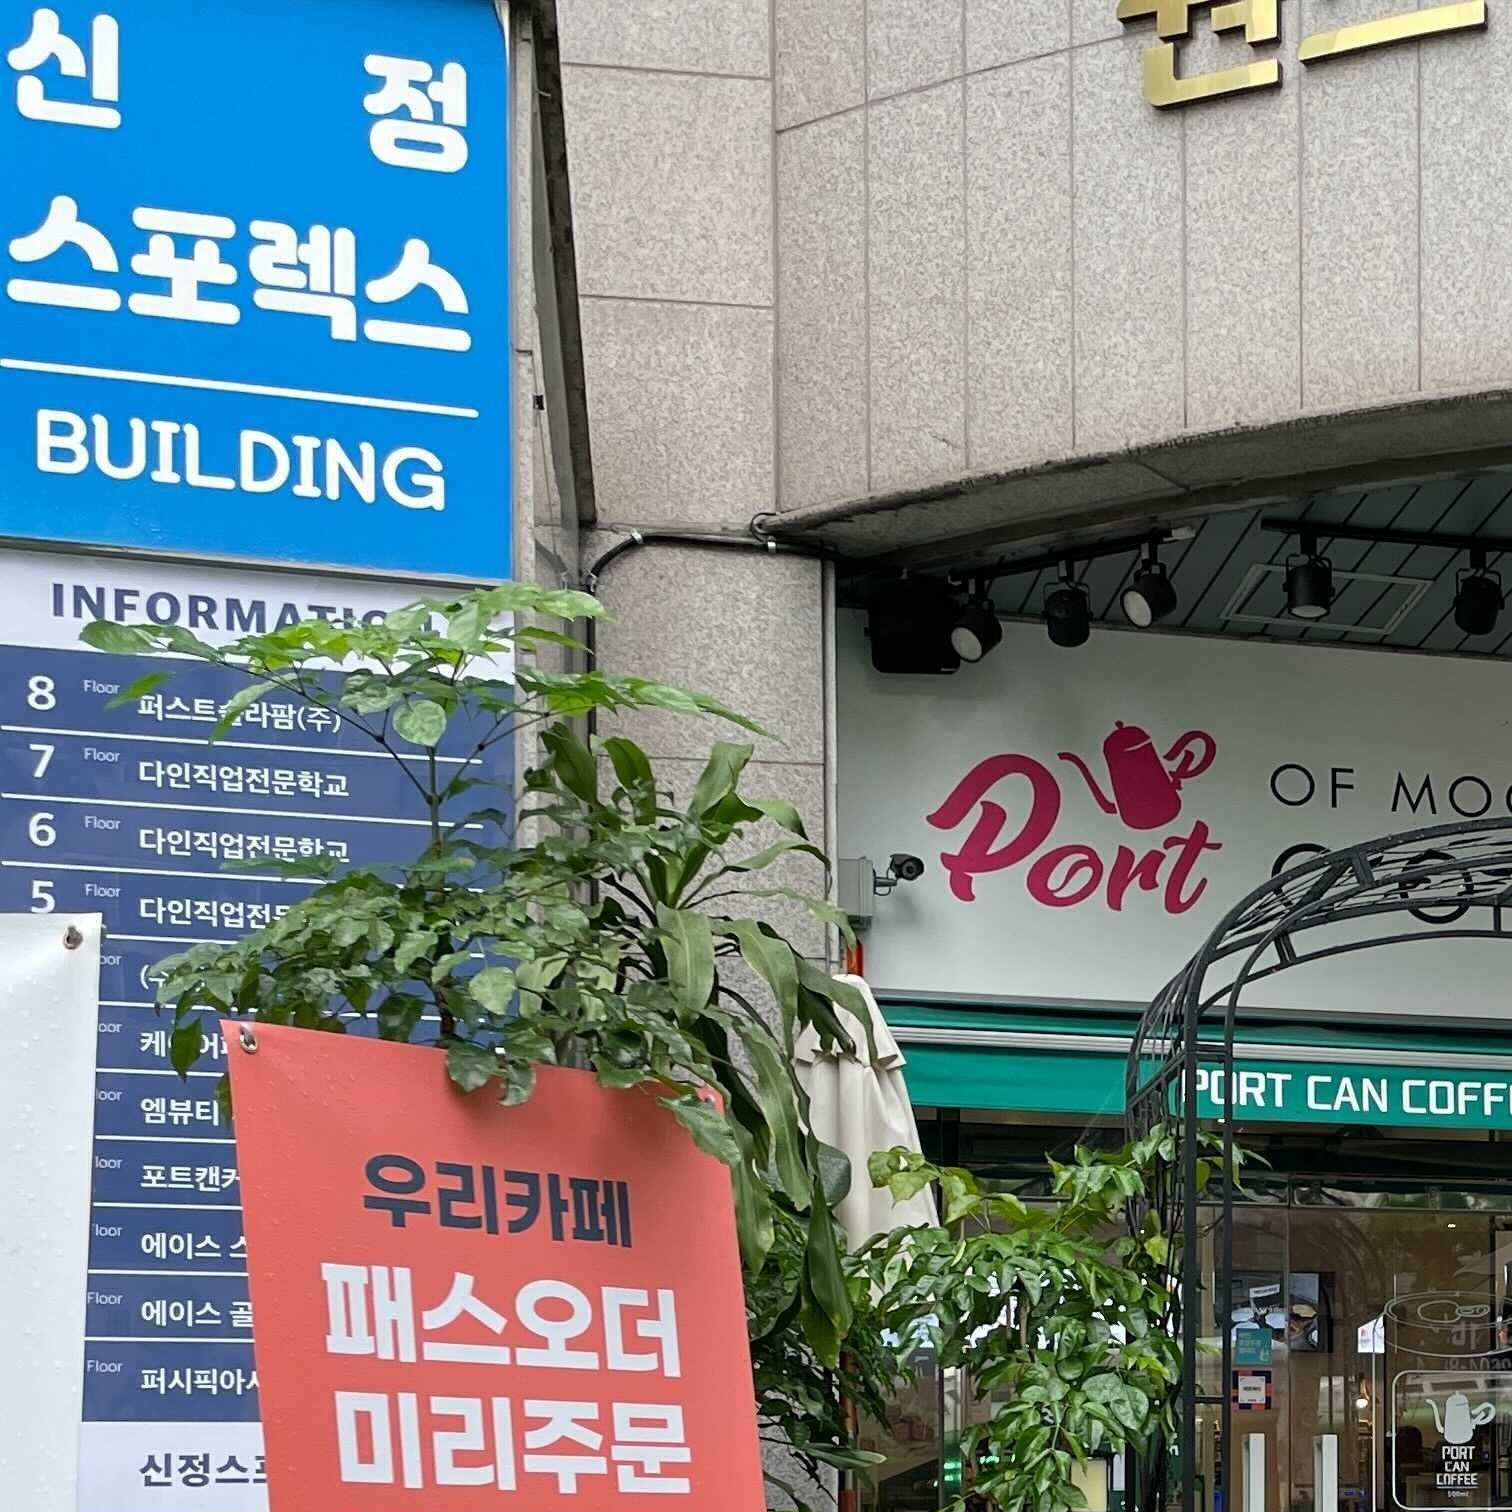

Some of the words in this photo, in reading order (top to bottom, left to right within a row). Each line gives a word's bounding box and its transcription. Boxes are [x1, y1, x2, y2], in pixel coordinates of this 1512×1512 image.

[7, 8, 121, 129] 신
[363, 54, 468, 173] 정
[7, 195, 472, 352] 스포렉스
[36, 409, 445, 511] BUILDING
[52, 582, 435, 638] INFORMAT
[27, 676, 56, 711] 8
[84, 680, 120, 695] Floor
[29, 744, 55, 778] 7
[84, 748, 120, 763] Floor
[138, 760, 349, 798] 다인직업전문학교
[1270, 763, 1354, 808] OF
[28, 812, 56, 846] 6
[84, 816, 121, 831] Floor
[139, 828, 349, 863] 다인직업전문학교
[926, 753, 1222, 915] Port
[31, 880, 55, 913] 5
[85, 884, 121, 899] Floor
[140, 1098, 219, 1126] 엠뷰티
[1181, 1069, 1292, 1108] PORT
[1307, 1075, 1388, 1113] CAN
[363, 1154, 632, 1248] 우리카페
[141, 1232, 222, 1260] 에이스
[87, 1292, 123, 1305] Floor
[141, 1300, 222, 1327] 에이스
[321, 1262, 681, 1378] 패스오더
[87, 1360, 123, 1373] Floor
[334, 1390, 692, 1494] 미리주문
[1442, 1446, 1475, 1460] PORT
[1436, 1473, 1478, 1485] COFFEE
[1445, 1461, 1469, 1472] CAN
